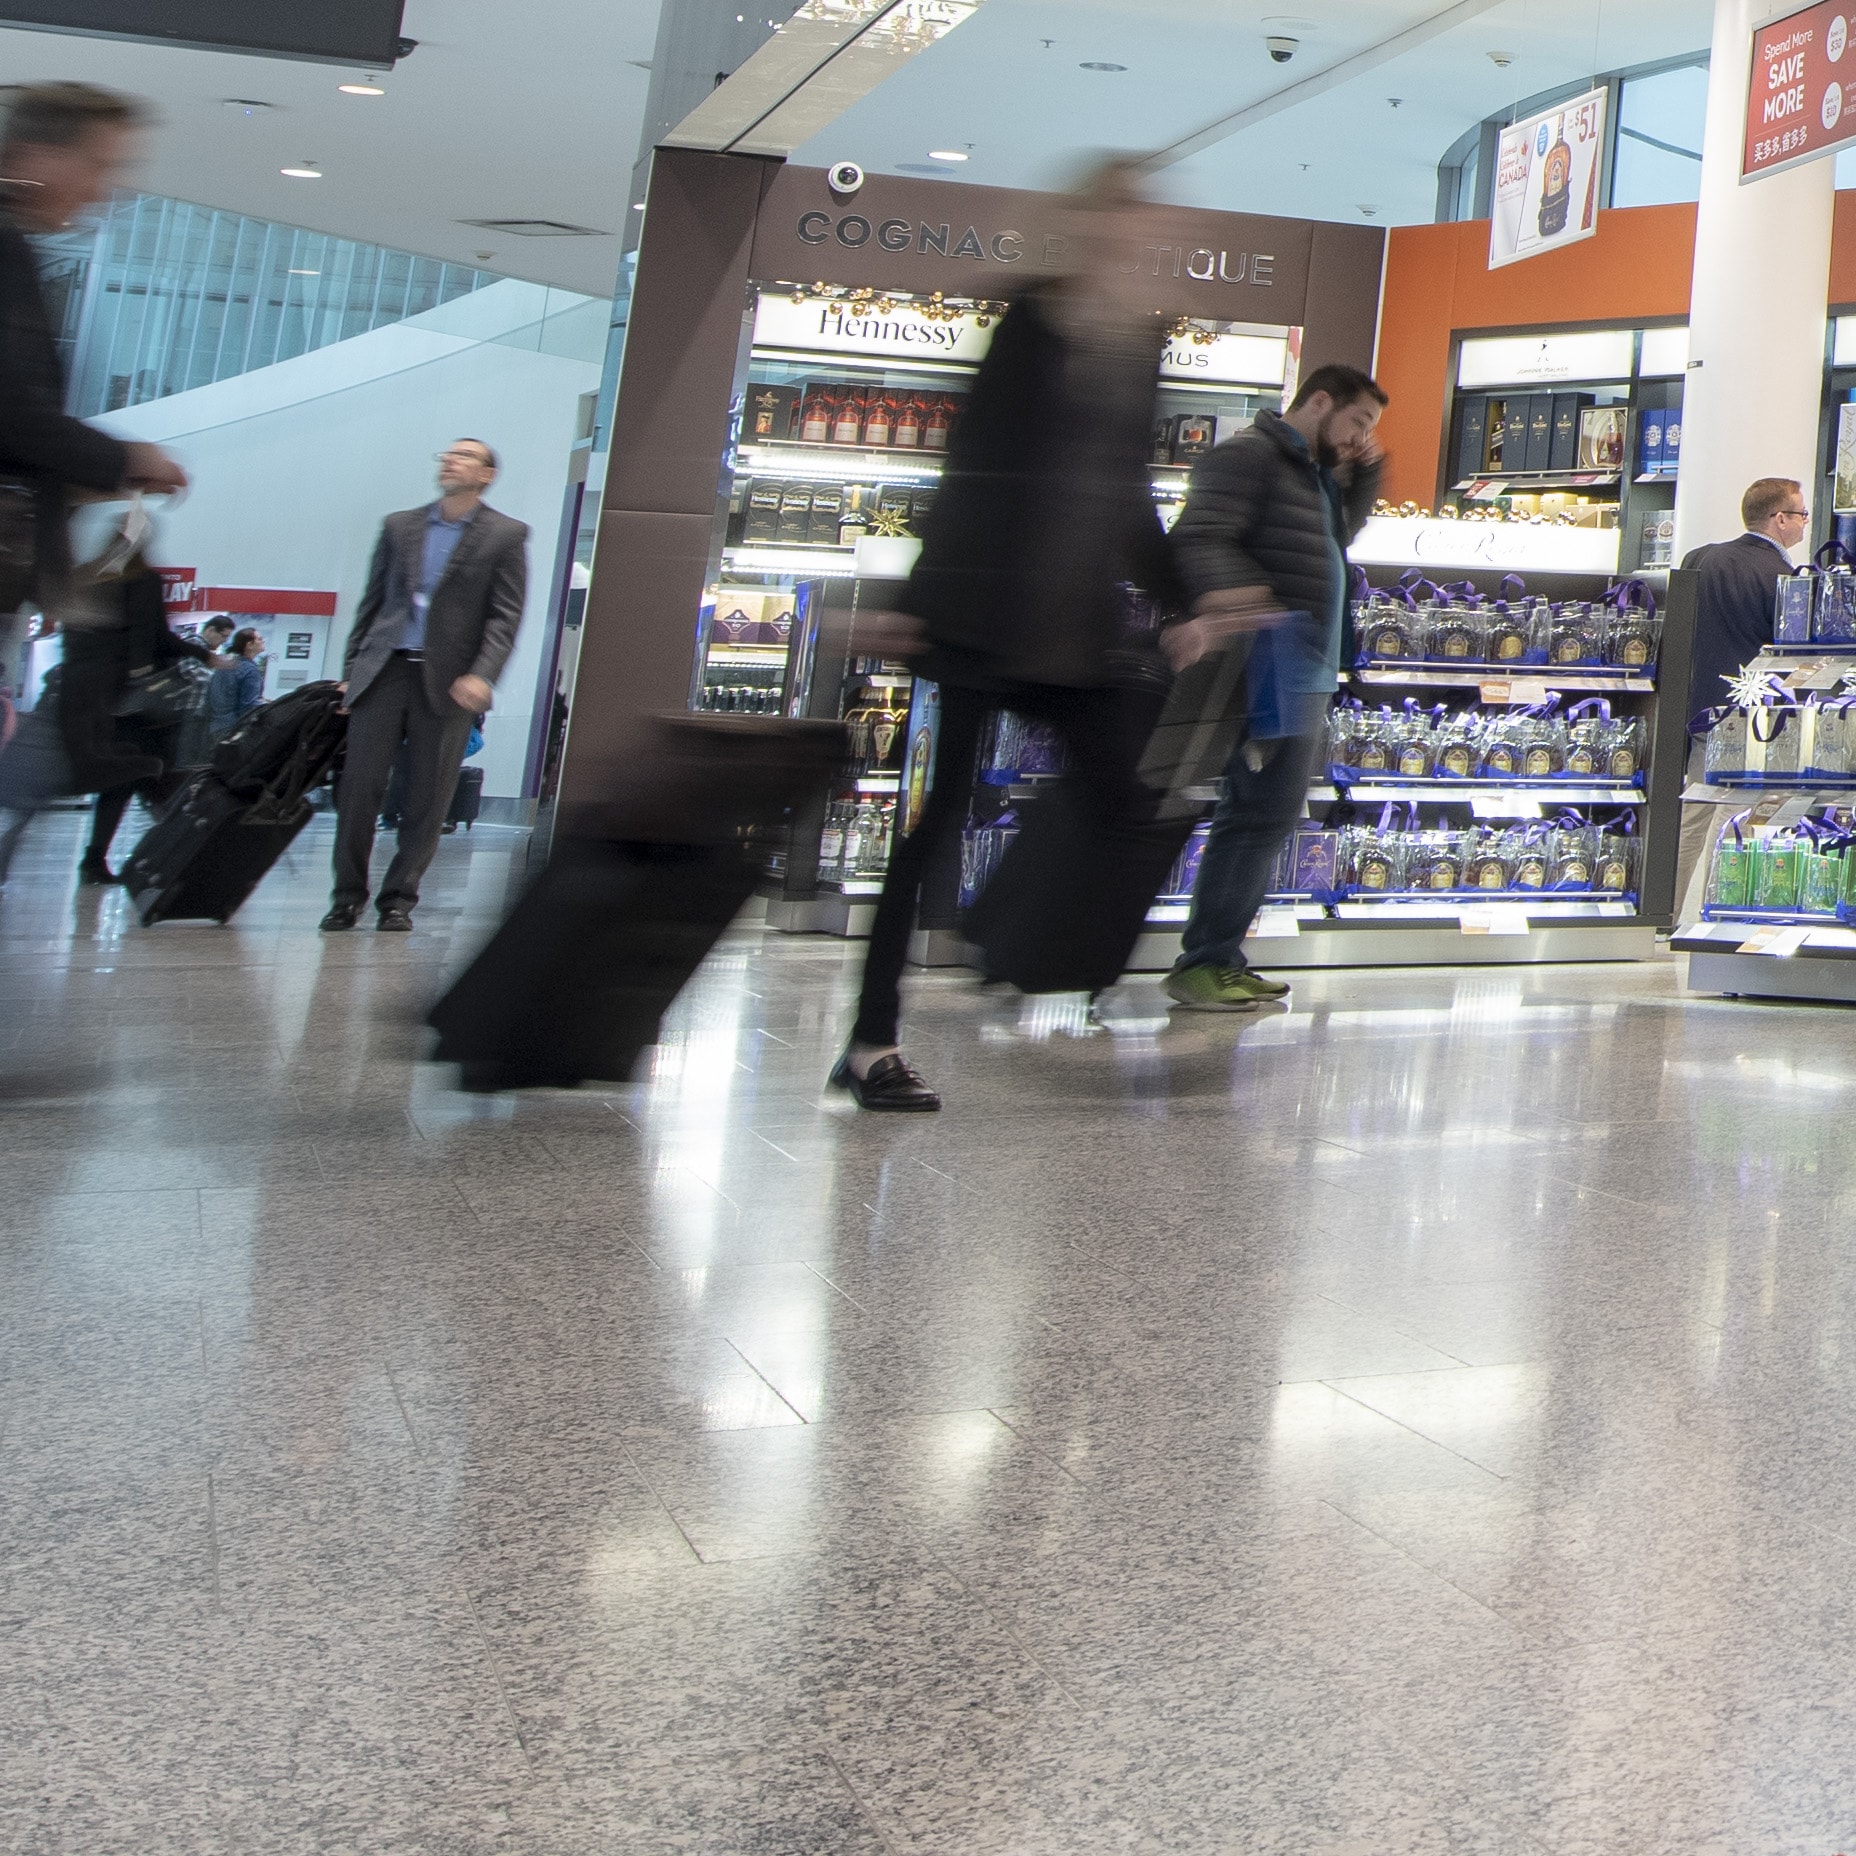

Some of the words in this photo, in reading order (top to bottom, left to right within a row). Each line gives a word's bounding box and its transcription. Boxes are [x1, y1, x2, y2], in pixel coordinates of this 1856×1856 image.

[1764, 39, 1791, 63] Spend
[1792, 29, 1813, 48] More
[1768, 52, 1805, 90] SAVE
[1763, 84, 1805, 124] MORE
[1499, 165, 1528, 188] CANADA
[797, 211, 1023, 262] COGNAC
[1042, 233, 1274, 285] BUTIQUE
[818, 309, 965, 349] Hennessy
